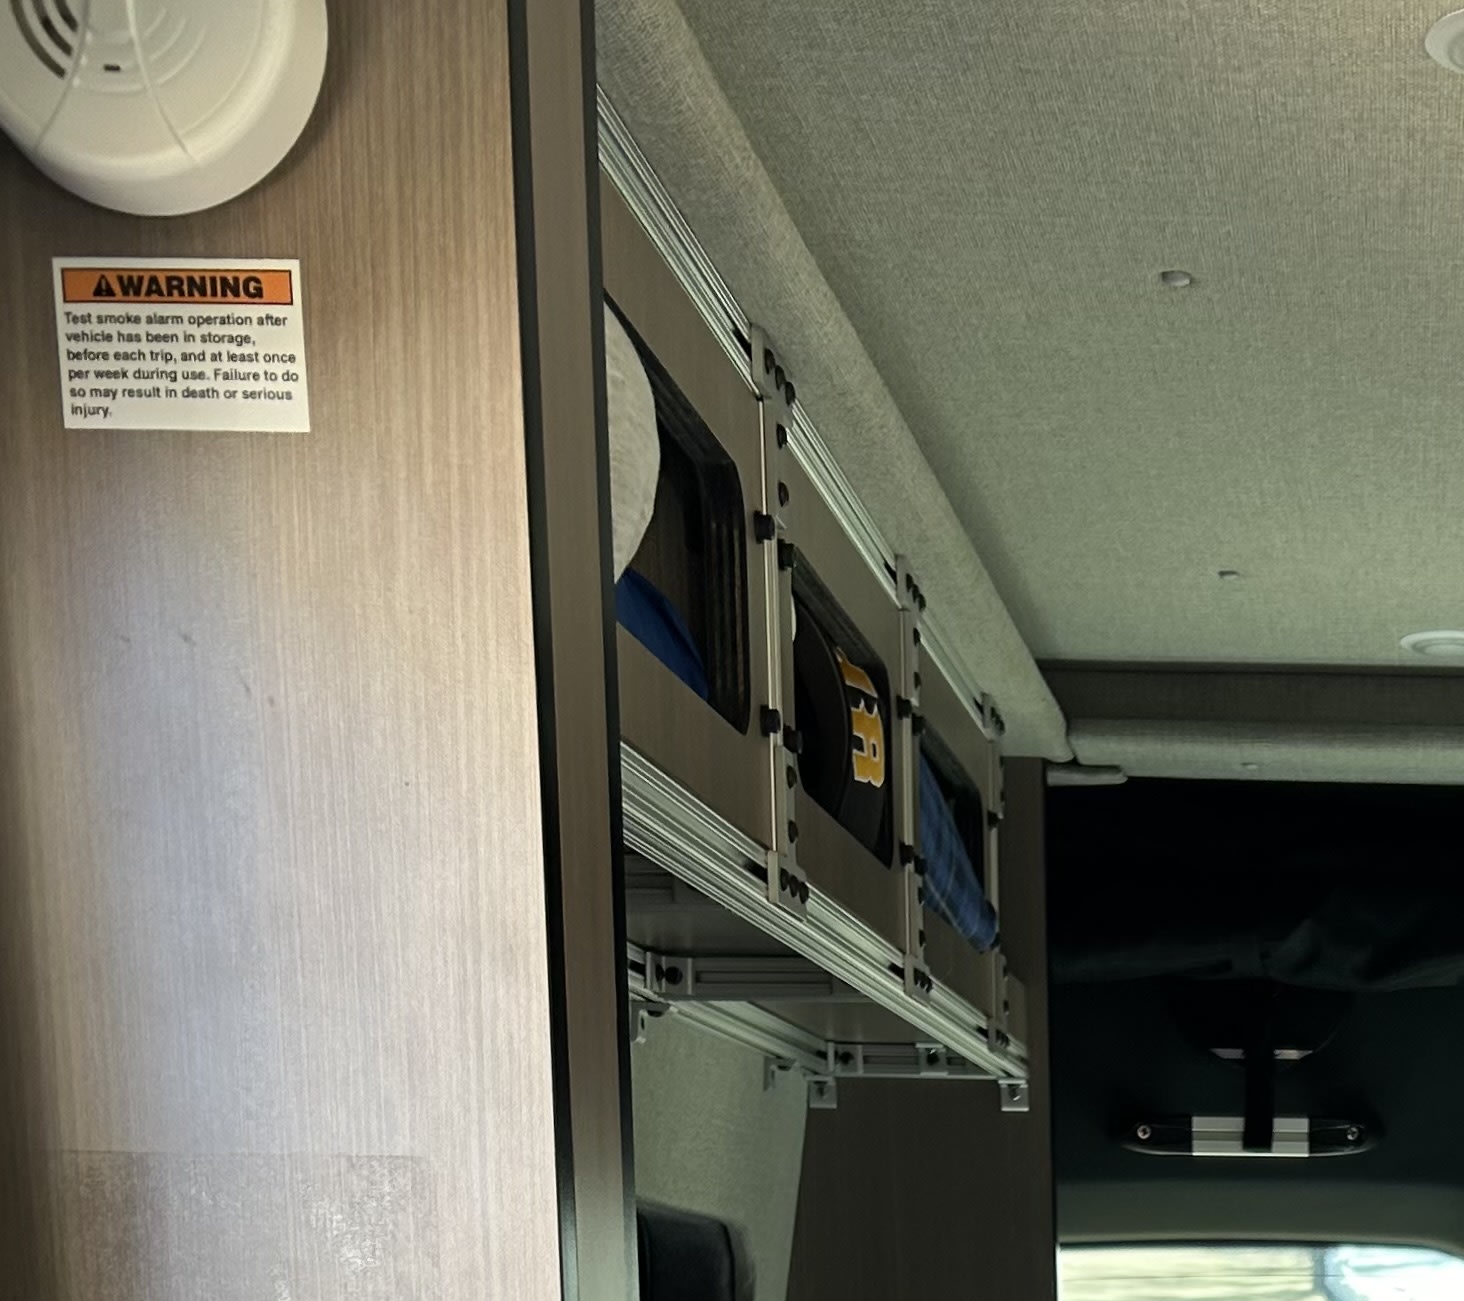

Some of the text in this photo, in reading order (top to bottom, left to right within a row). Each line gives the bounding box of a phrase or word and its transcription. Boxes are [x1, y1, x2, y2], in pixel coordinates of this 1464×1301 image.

[117, 274, 264, 299] WARNING
[64, 312, 288, 328] Test smoke alarm operation after
[65, 330, 256, 346] vehicle has been in storage,
[66, 348, 296, 364] before each trip, and at least once
[68, 369, 90, 381] per
[94, 367, 129, 379] week
[133, 367, 178, 382] during
[213, 368, 260, 381] Failure
[263, 370, 278, 381] to
[281, 370, 299, 382] do
[69, 387, 293, 401] so may result in death or serious
